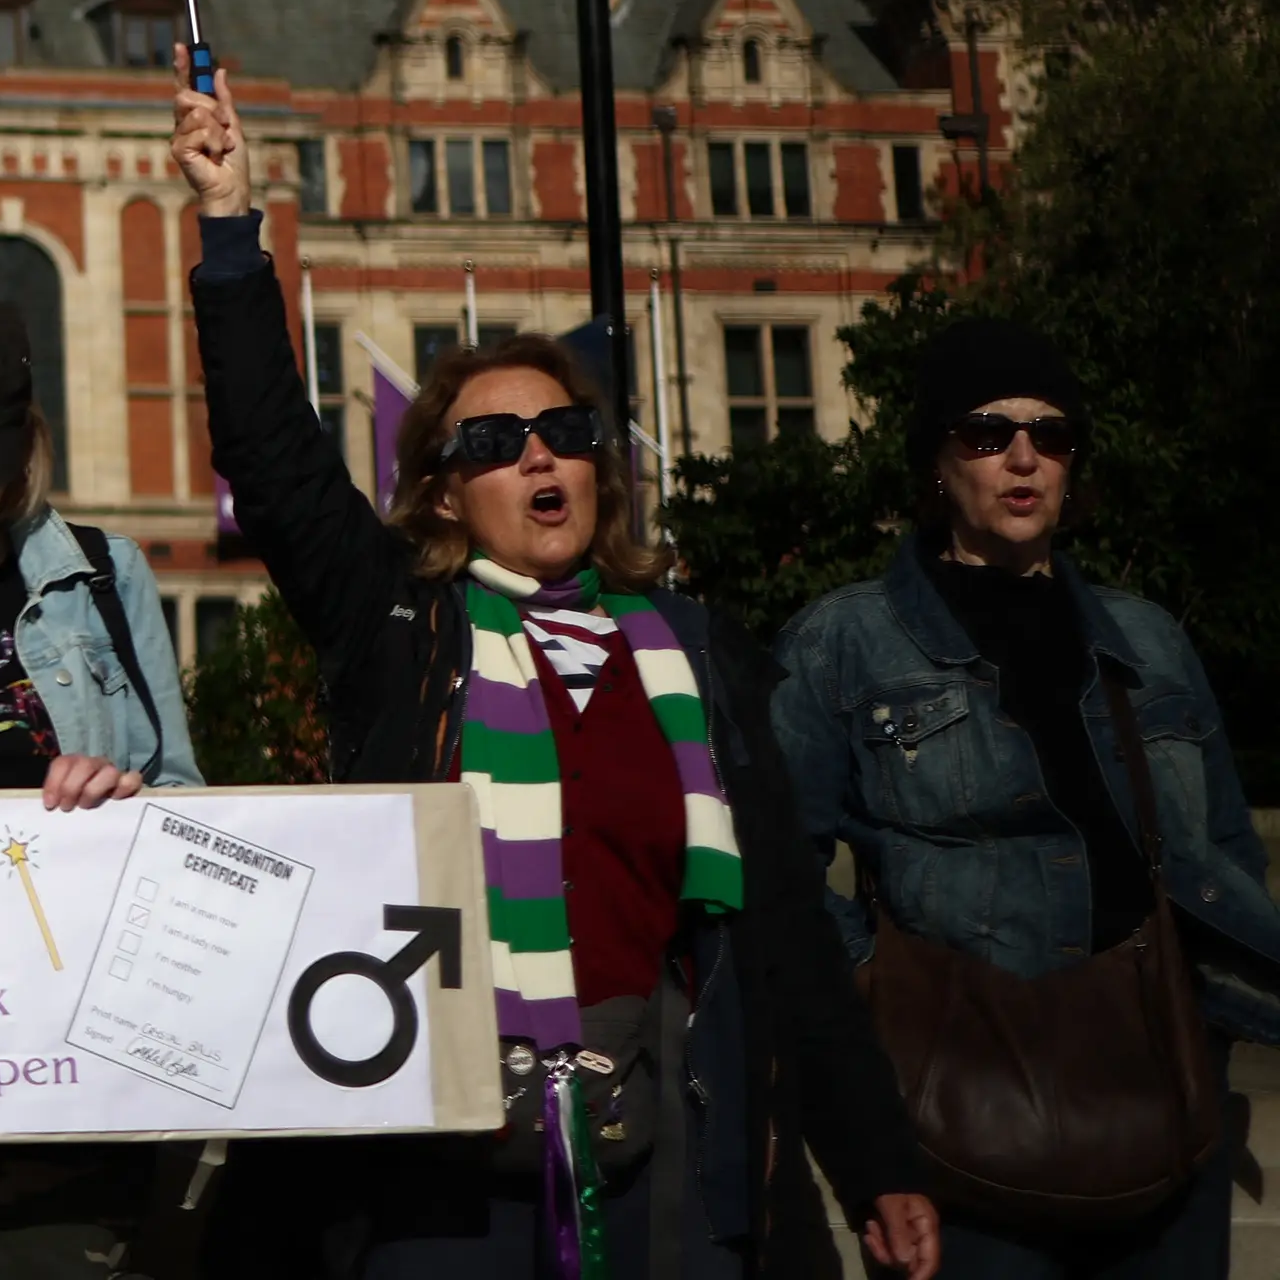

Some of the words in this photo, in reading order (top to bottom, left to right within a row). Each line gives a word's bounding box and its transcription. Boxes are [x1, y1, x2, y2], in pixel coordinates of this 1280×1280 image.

[161, 816, 211, 849] GENDER
[214, 836, 292, 880] RECOGNITION
[184, 853, 258, 894] CERTIFICATE
